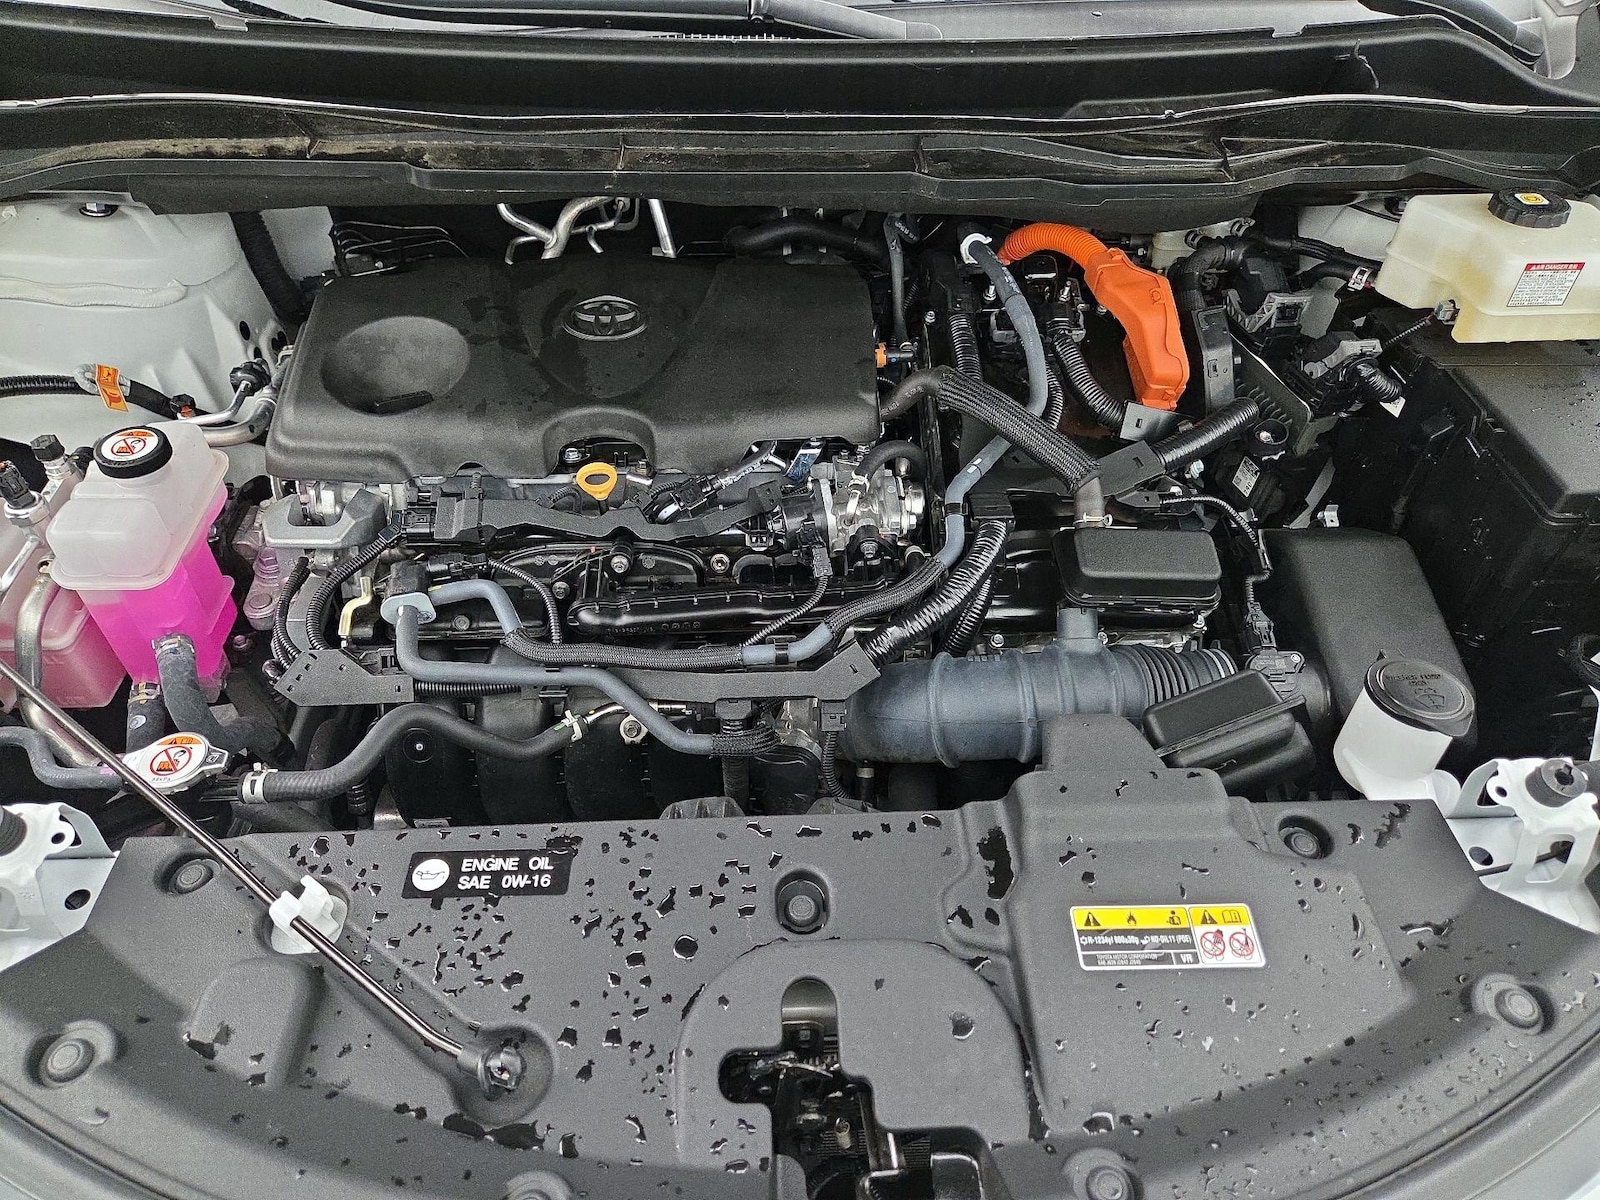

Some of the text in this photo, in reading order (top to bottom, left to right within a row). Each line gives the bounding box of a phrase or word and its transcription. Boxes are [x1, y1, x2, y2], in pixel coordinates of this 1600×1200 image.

[461, 856, 554, 872] ENGINE OIL
[457, 874, 551, 890] SAE 0W-16
[1180, 953, 1193, 964] VR
